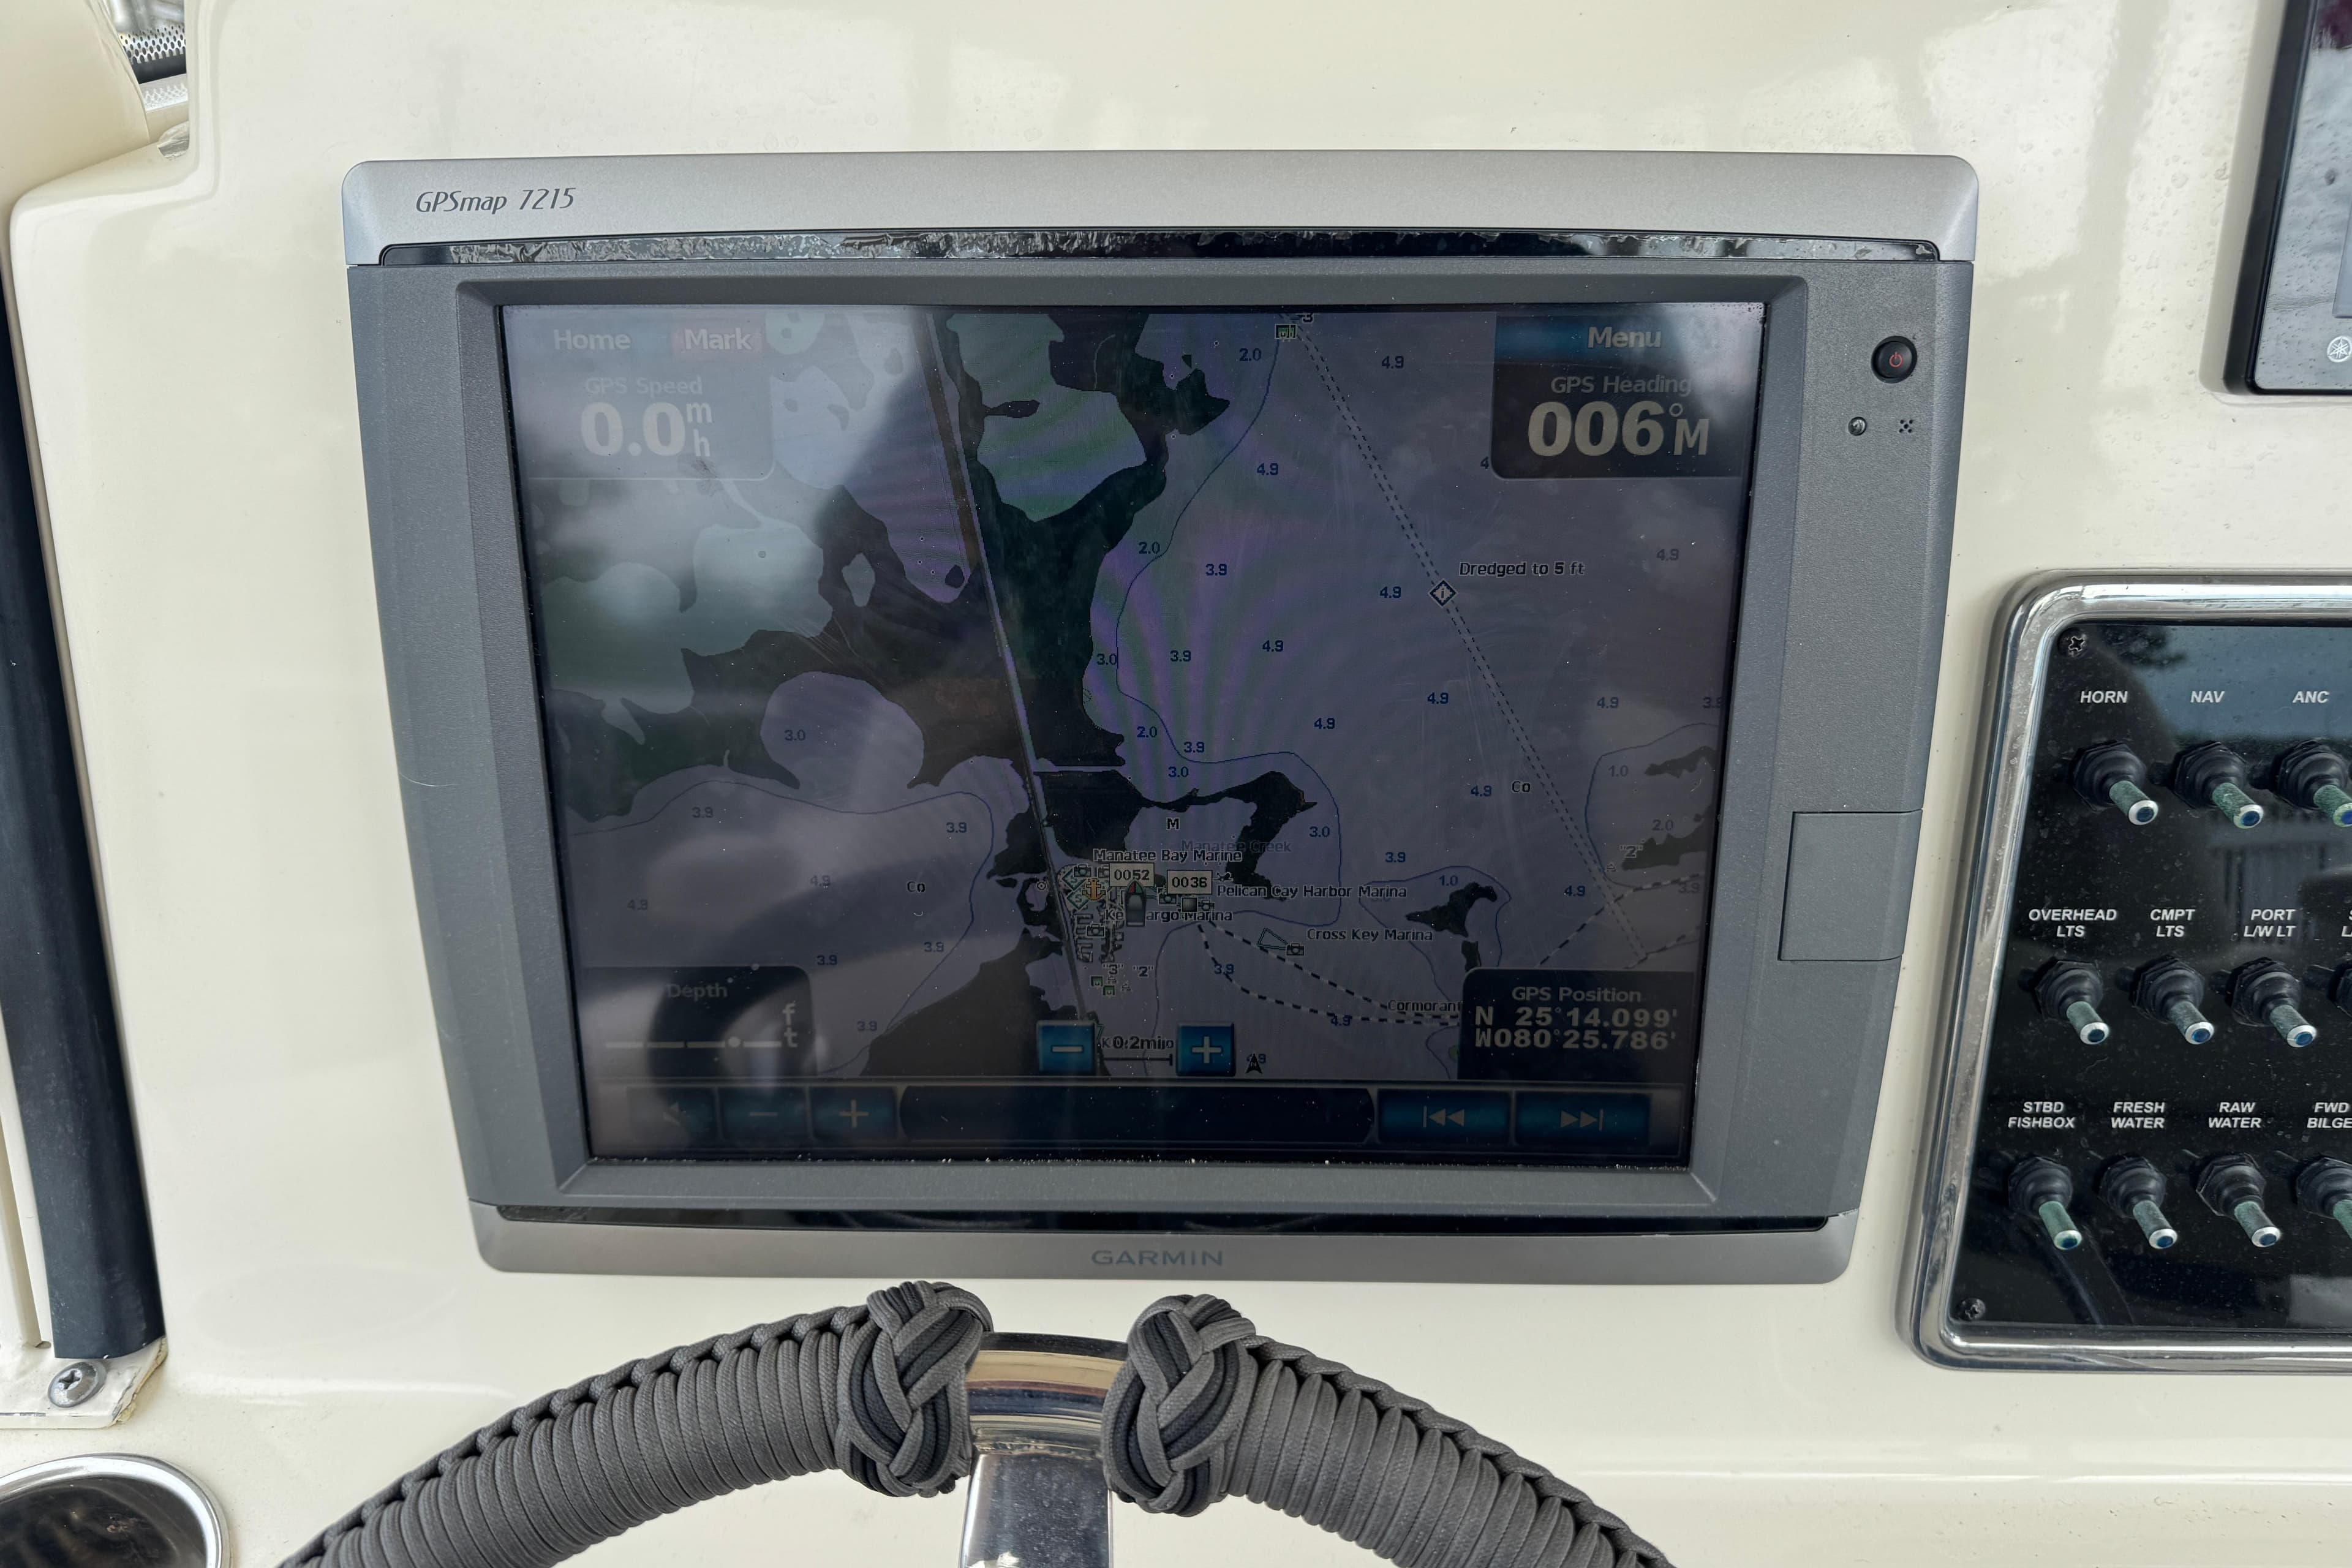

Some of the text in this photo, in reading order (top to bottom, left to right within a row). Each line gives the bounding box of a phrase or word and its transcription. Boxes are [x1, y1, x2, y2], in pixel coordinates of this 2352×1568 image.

[415, 187, 576, 214] GPSmap 7215
[554, 328, 752, 350] Home Mark
[1588, 327, 1662, 348] Menu
[1240, 349, 1261, 361] 2.0
[1381, 356, 1404, 368] 4.9
[585, 377, 702, 397] GPS Speed
[1551, 375, 1691, 396] GPS Heading
[580, 402, 686, 456] 0.0
[1257, 464, 1278, 475] 4.9
[1139, 543, 1160, 554] 2.0
[1657, 549, 1679, 561] 4.9
[1206, 564, 1227, 576] 3.9
[1460, 562, 1585, 577] Dredged to 5 ft
[1379, 586, 1401, 598] 4.9
[1262, 639, 1284, 651] 4.9
[1097, 654, 1117, 665] 3.0
[1170, 650, 1191, 662] 3.9
[1427, 692, 1449, 704] 4.9
[1597, 696, 1619, 709] 4.9
[2080, 691, 2128, 703] HORN
[2190, 691, 2224, 703] NAV
[2293, 691, 2329, 703] ANC
[1314, 717, 1335, 729] 4.9
[785, 729, 805, 741] 3.0
[1137, 726, 1158, 738] 2.0
[1184, 741, 1205, 753] 3.9
[1169, 766, 1189, 778] 3.0
[1608, 765, 1629, 777] 1.0
[1471, 785, 1492, 796] 4.9
[1511, 781, 1531, 793] Co
[692, 807, 714, 818] 3.9
[946, 822, 967, 833] 3.9
[1167, 818, 1179, 829] M
[1652, 820, 1674, 831] 2.0
[1309, 826, 1330, 837] 3.0
[1250, 840, 1291, 852] Creek
[1093, 850, 1242, 863] Manatee Bay Marine
[1385, 851, 1406, 862] 3.9
[1114, 870, 1150, 880] 0052
[1439, 875, 1458, 886] 1.0
[1172, 877, 1207, 888] 0036
[1217, 886, 1267, 897] Pelican
[1303, 886, 1352, 897] Harbor
[1359, 886, 1407, 897] Marina
[1564, 886, 1585, 896] 4.9
[1146, 911, 1178, 922] argo
[1184, 911, 1232, 921] Marina
[2028, 909, 2117, 921] OVERHEAD
[2150, 909, 2195, 921] CMPT
[2250, 909, 2296, 921] PORT
[1307, 929, 1433, 943] Cross Key Marina
[2056, 925, 2085, 937] LTS
[2156, 925, 2185, 937] LTS
[2244, 925, 2296, 937] L/W LT
[816, 955, 838, 966] 3.9
[665, 985, 727, 1000] Depth
[1512, 987, 1642, 1001] GPS Position
[1476, 1006, 1493, 1025] N
[2022, 1102, 2064, 1113] STBD
[2113, 1102, 2165, 1113] FRESH
[2218, 1102, 2255, 1113] RAW
[2314, 1102, 2350, 1113] FWD
[2008, 1117, 2075, 1128] FISHBOX
[2111, 1117, 2165, 1128] WATER
[2208, 1117, 2261, 1128] WATER
[2307, 1117, 2352, 1128] BILGE
[1091, 1250, 1223, 1266] GARMIN
